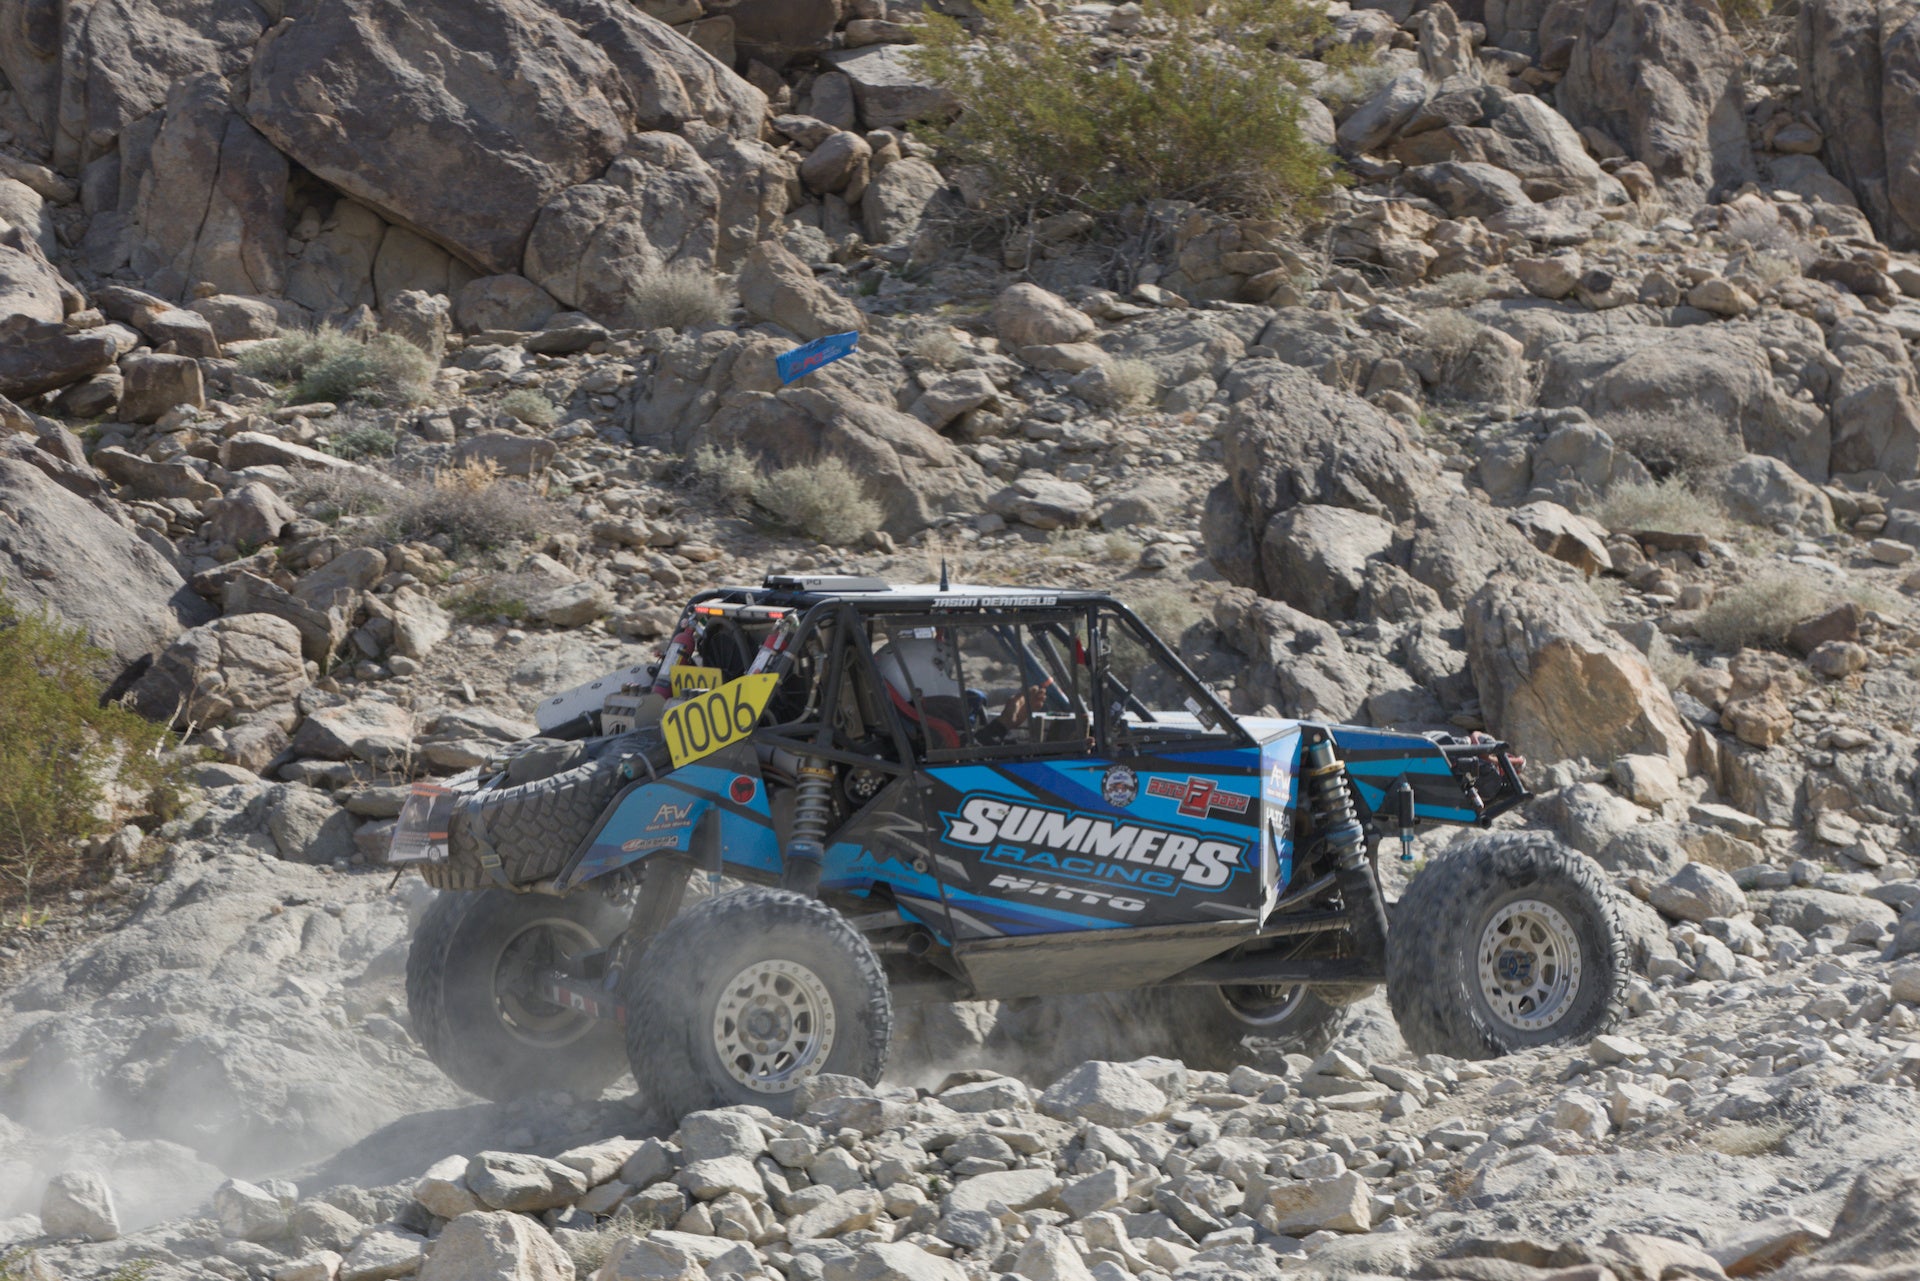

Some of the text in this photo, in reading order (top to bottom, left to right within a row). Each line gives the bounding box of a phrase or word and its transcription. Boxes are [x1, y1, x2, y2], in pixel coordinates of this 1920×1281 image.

[932, 596, 1058, 607] JASON DEANGELIS
[667, 683, 756, 757] 1006
[653, 802, 693, 823] AFW
[1150, 781, 1185, 797] AUTO
[1211, 791, 1247, 809] BODY
[949, 799, 1241, 886] SUMMERS
[991, 845, 1176, 887] RACING
[988, 874, 1147, 912] NITTO
